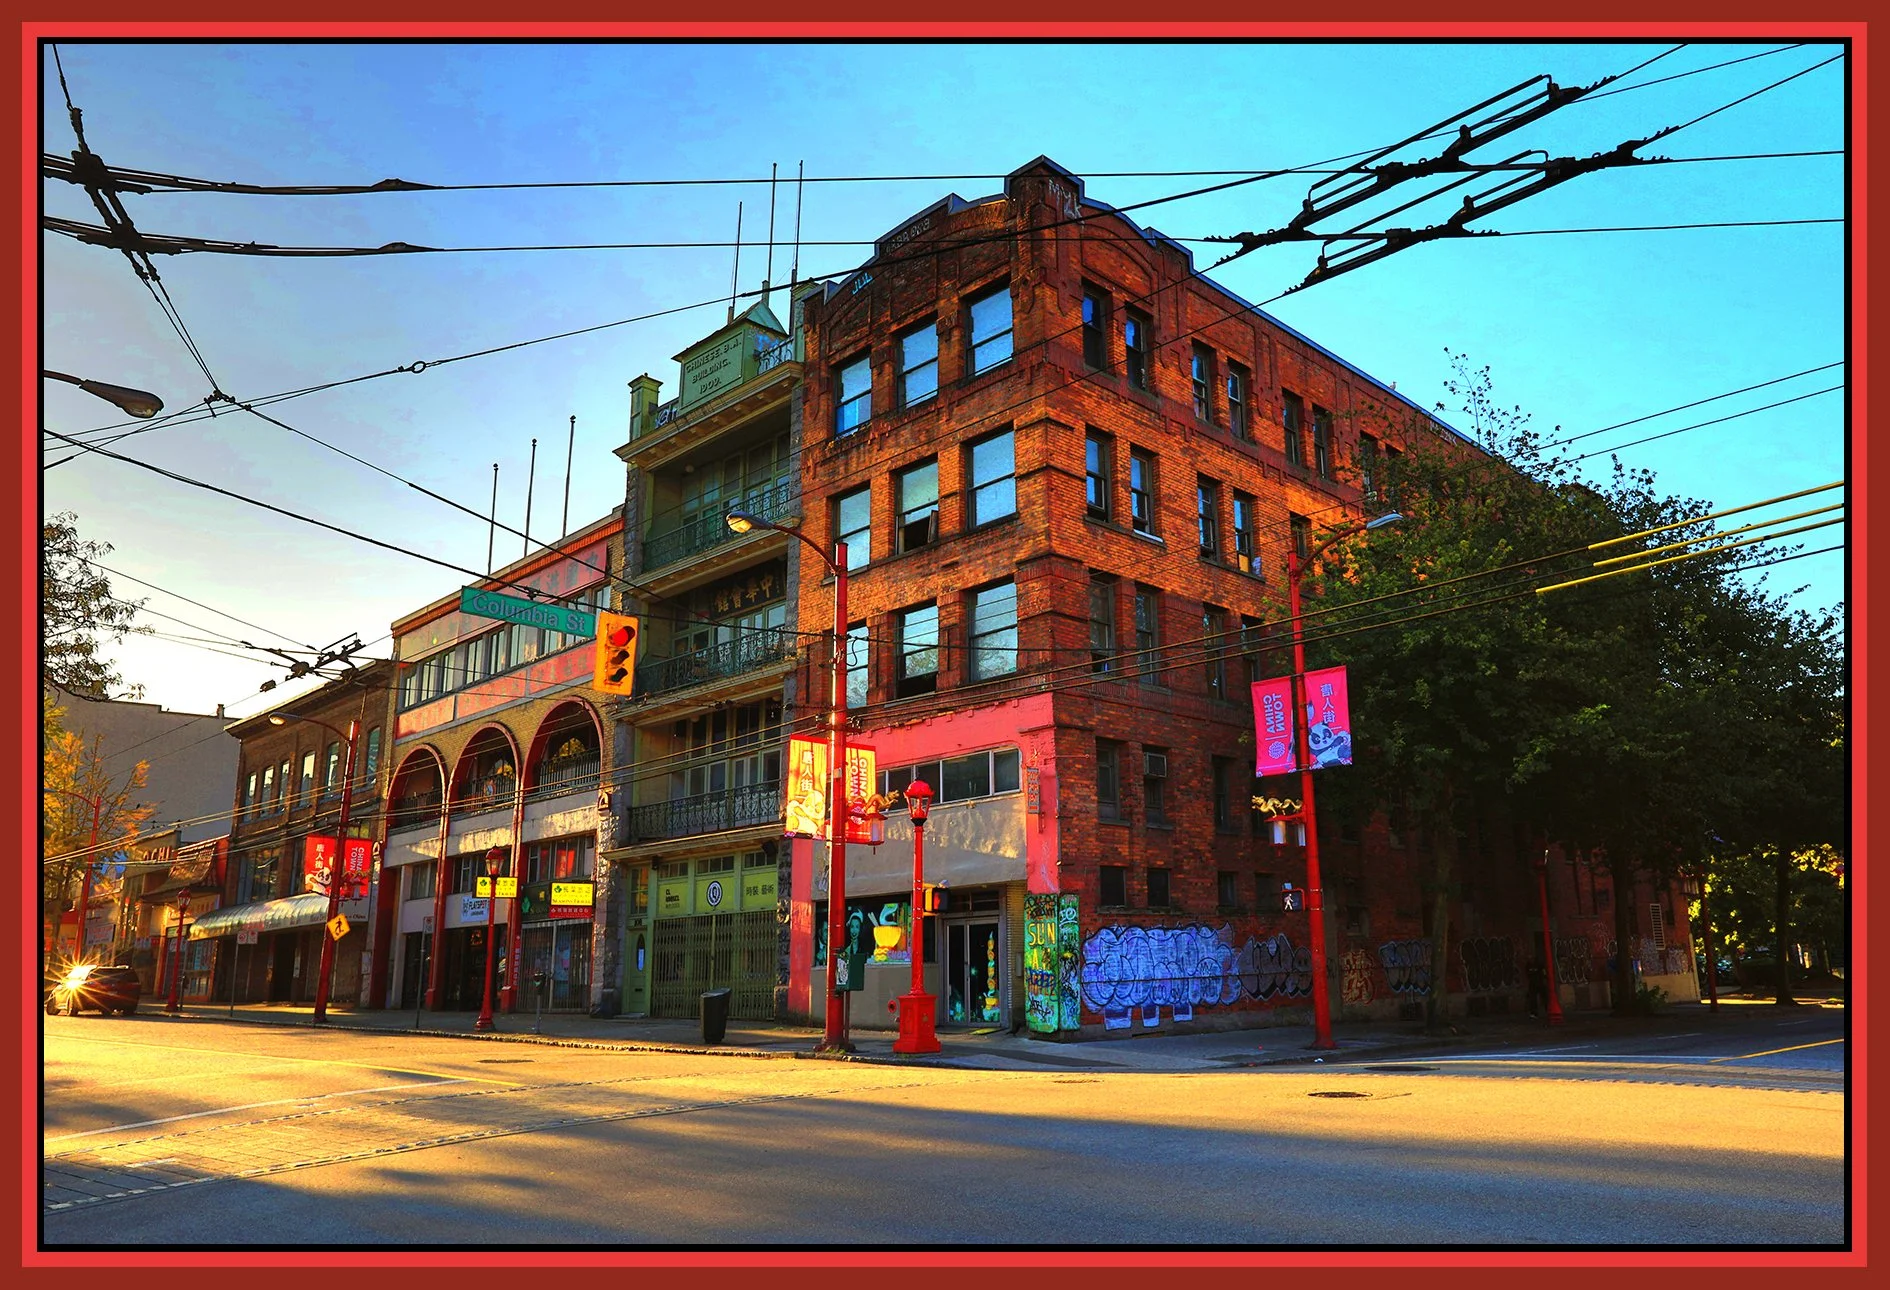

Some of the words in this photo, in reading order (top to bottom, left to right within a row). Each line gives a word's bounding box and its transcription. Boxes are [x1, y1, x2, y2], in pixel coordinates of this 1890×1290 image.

[473, 594, 558, 627] Columbia
[566, 613, 585, 632] St
[850, 757, 859, 797] TOWN
[349, 846, 358, 871] TOWN
[1029, 922, 1056, 946] SUN
